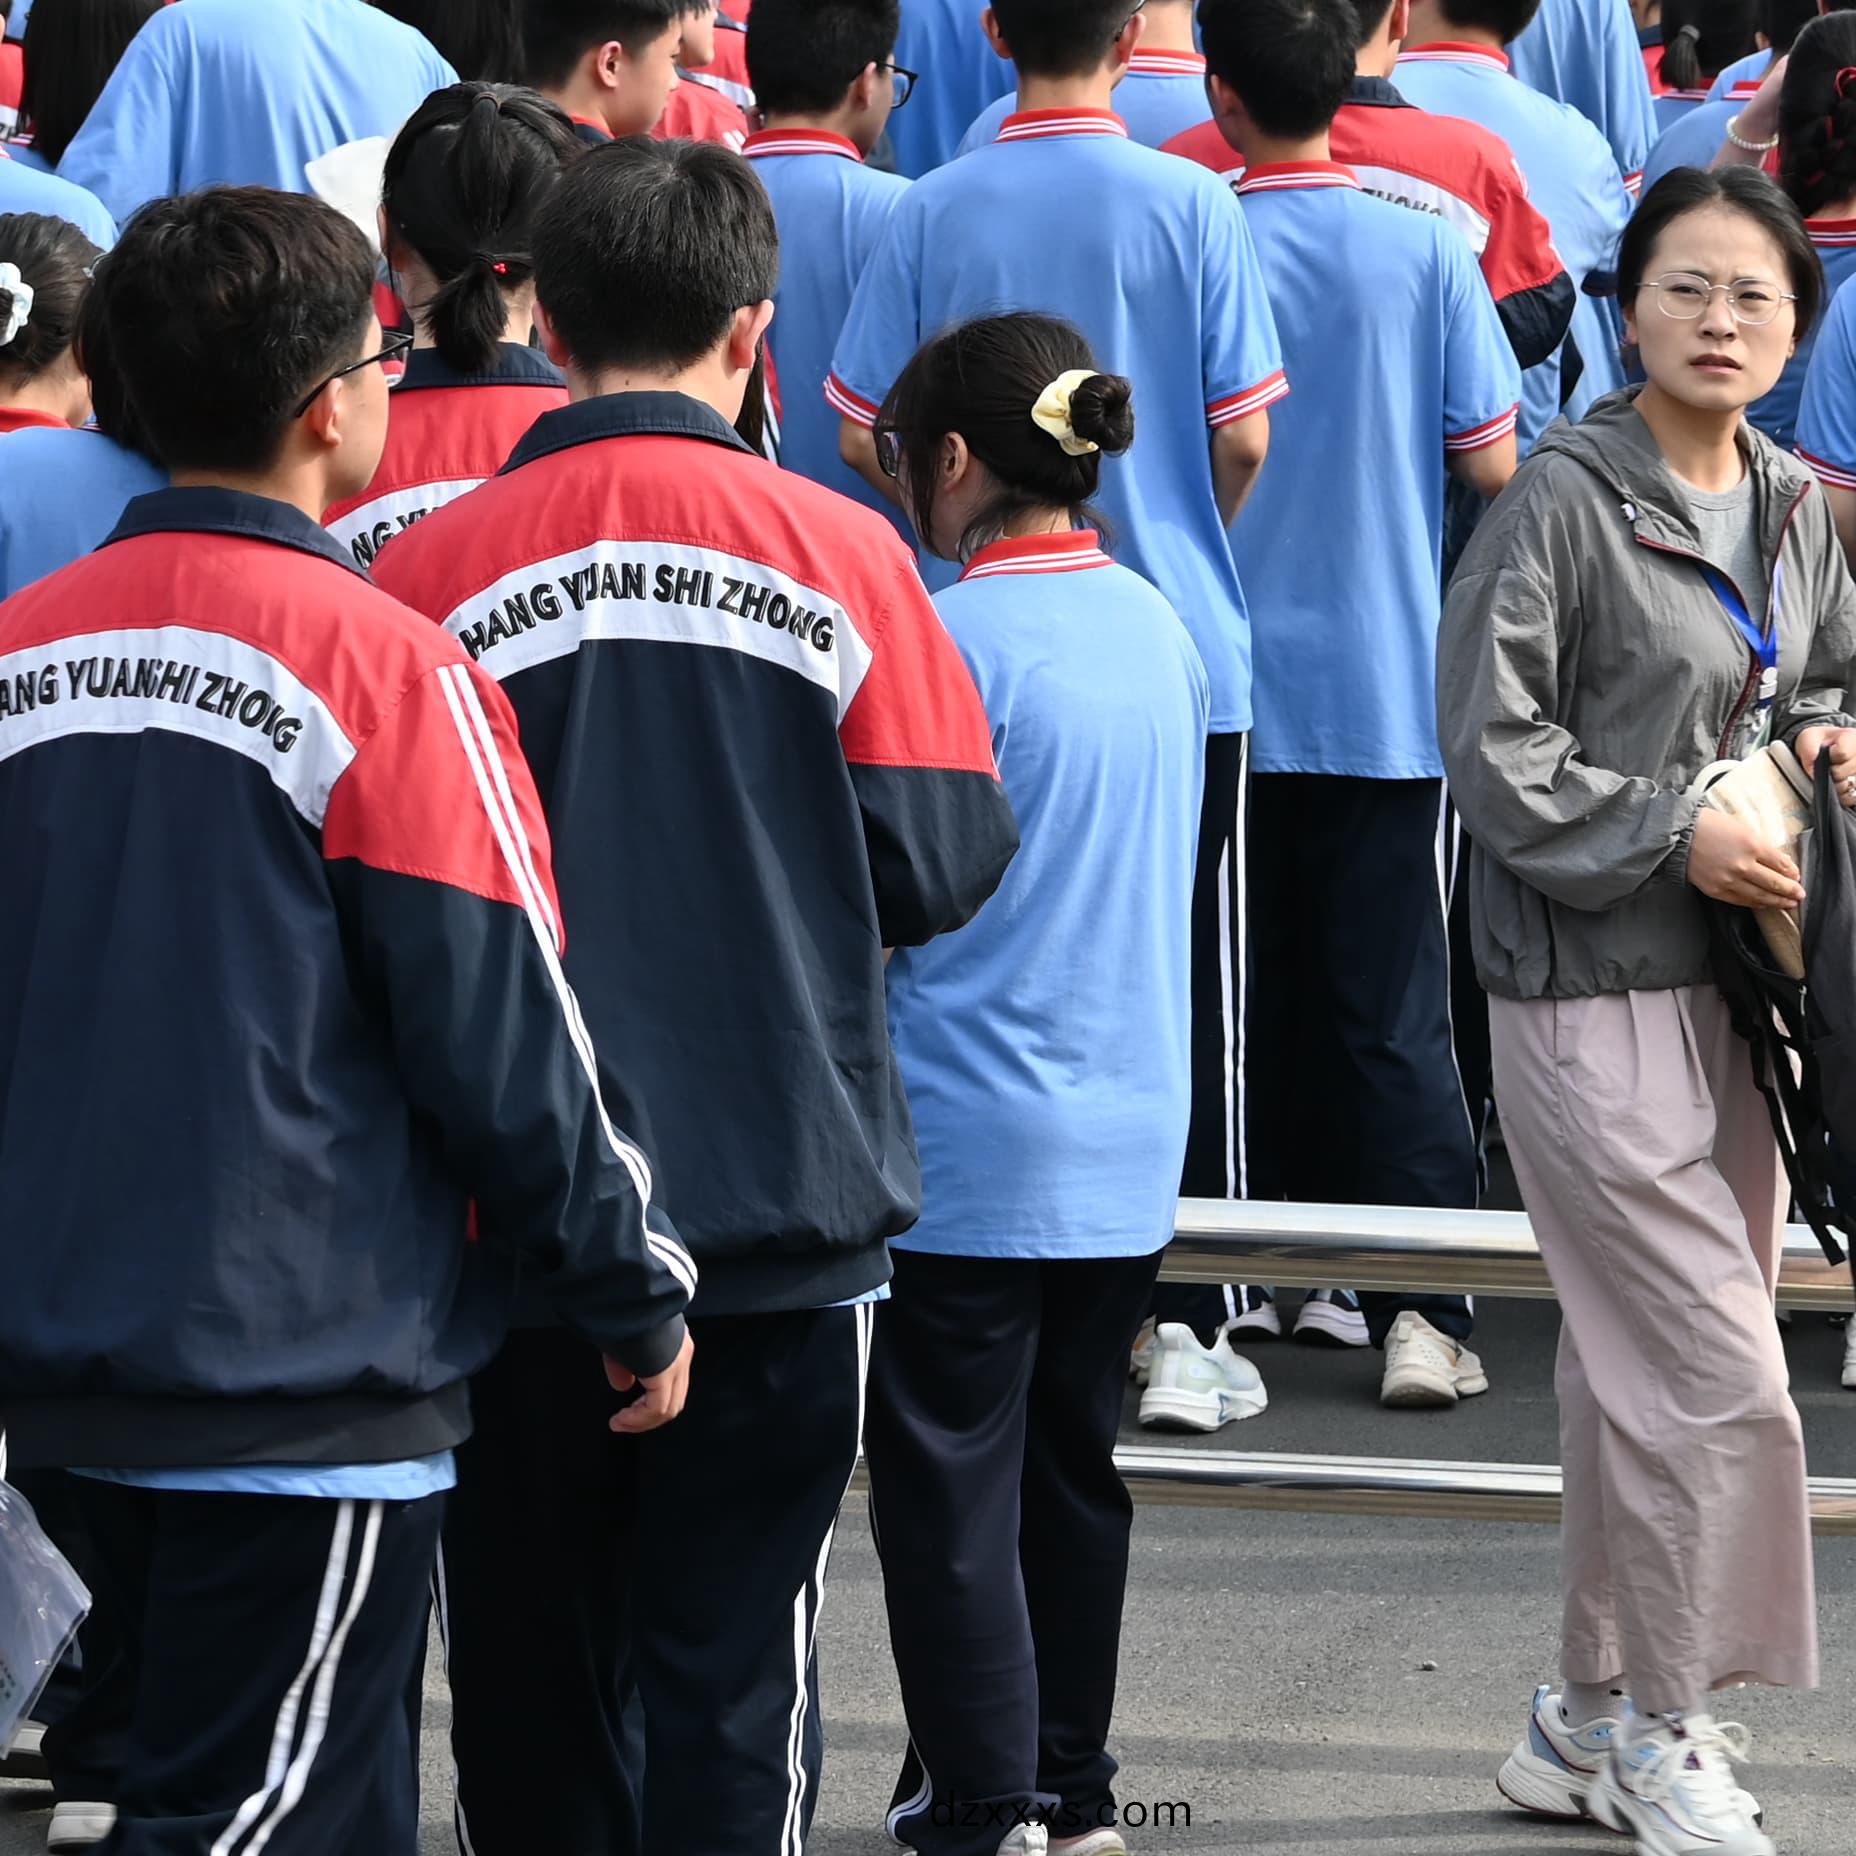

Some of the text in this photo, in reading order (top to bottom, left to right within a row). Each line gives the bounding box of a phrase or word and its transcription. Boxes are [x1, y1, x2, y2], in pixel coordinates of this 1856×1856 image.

[558, 562, 646, 611] YUAN
[652, 563, 712, 608] SHI
[716, 576, 836, 653] ZHONG
